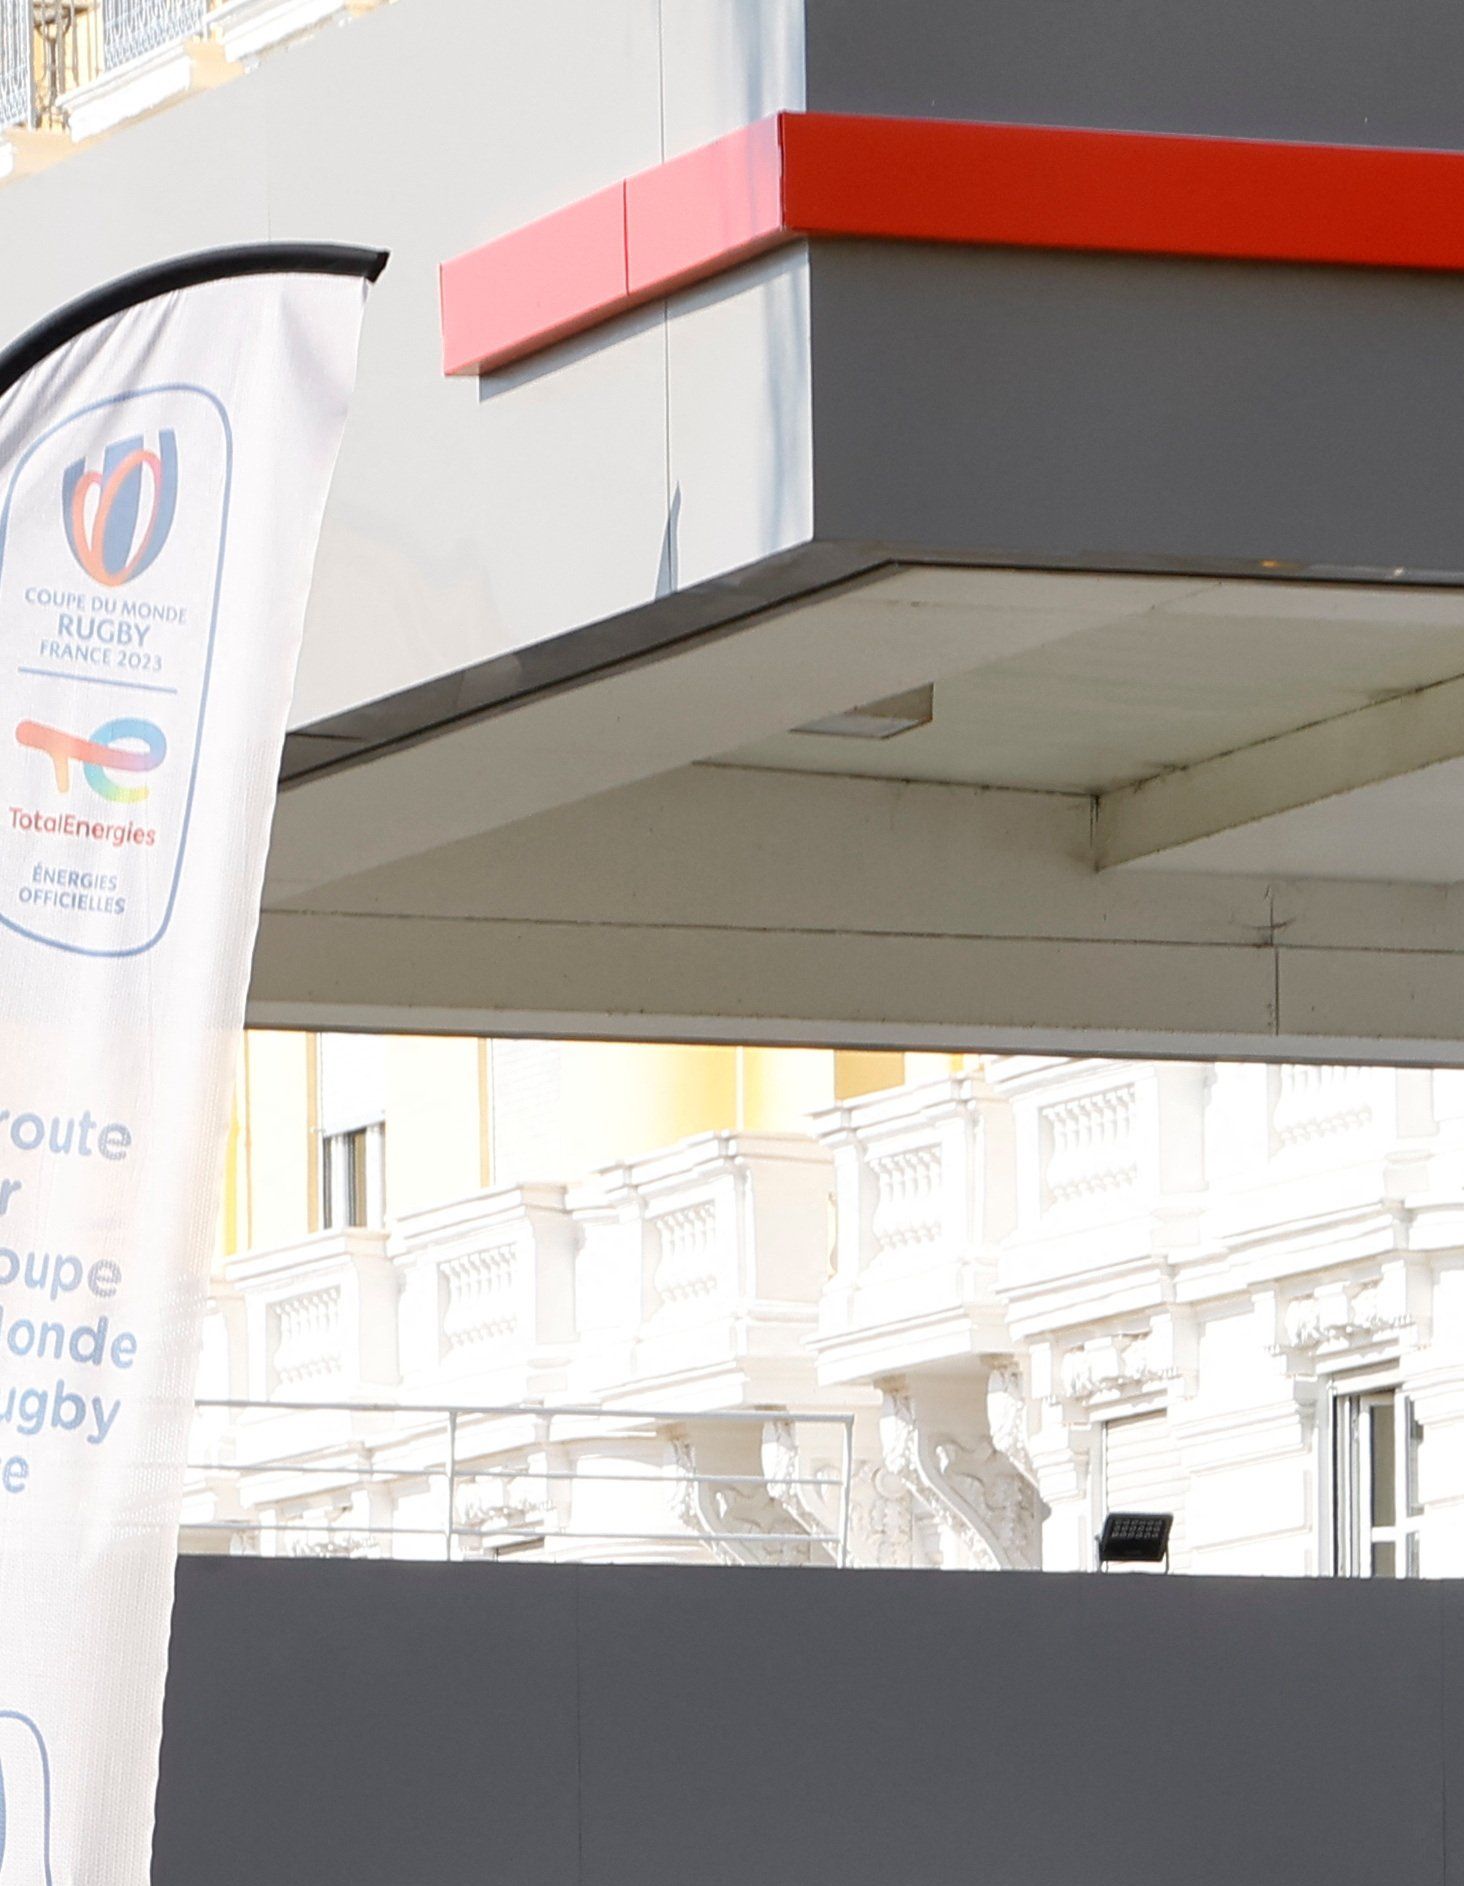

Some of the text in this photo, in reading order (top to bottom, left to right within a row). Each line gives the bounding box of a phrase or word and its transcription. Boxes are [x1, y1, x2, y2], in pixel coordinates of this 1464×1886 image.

[25, 587, 187, 624] COUPE DU MONDE
[57, 613, 150, 647] RUGBY
[40, 639, 162, 672] FRANCE 2023
[9, 806, 156, 847] TotalEnergies
[32, 861, 117, 891] ÉNERGIES
[19, 886, 126, 915] OFFICIELLES
[0, 1308, 137, 1369] onde
